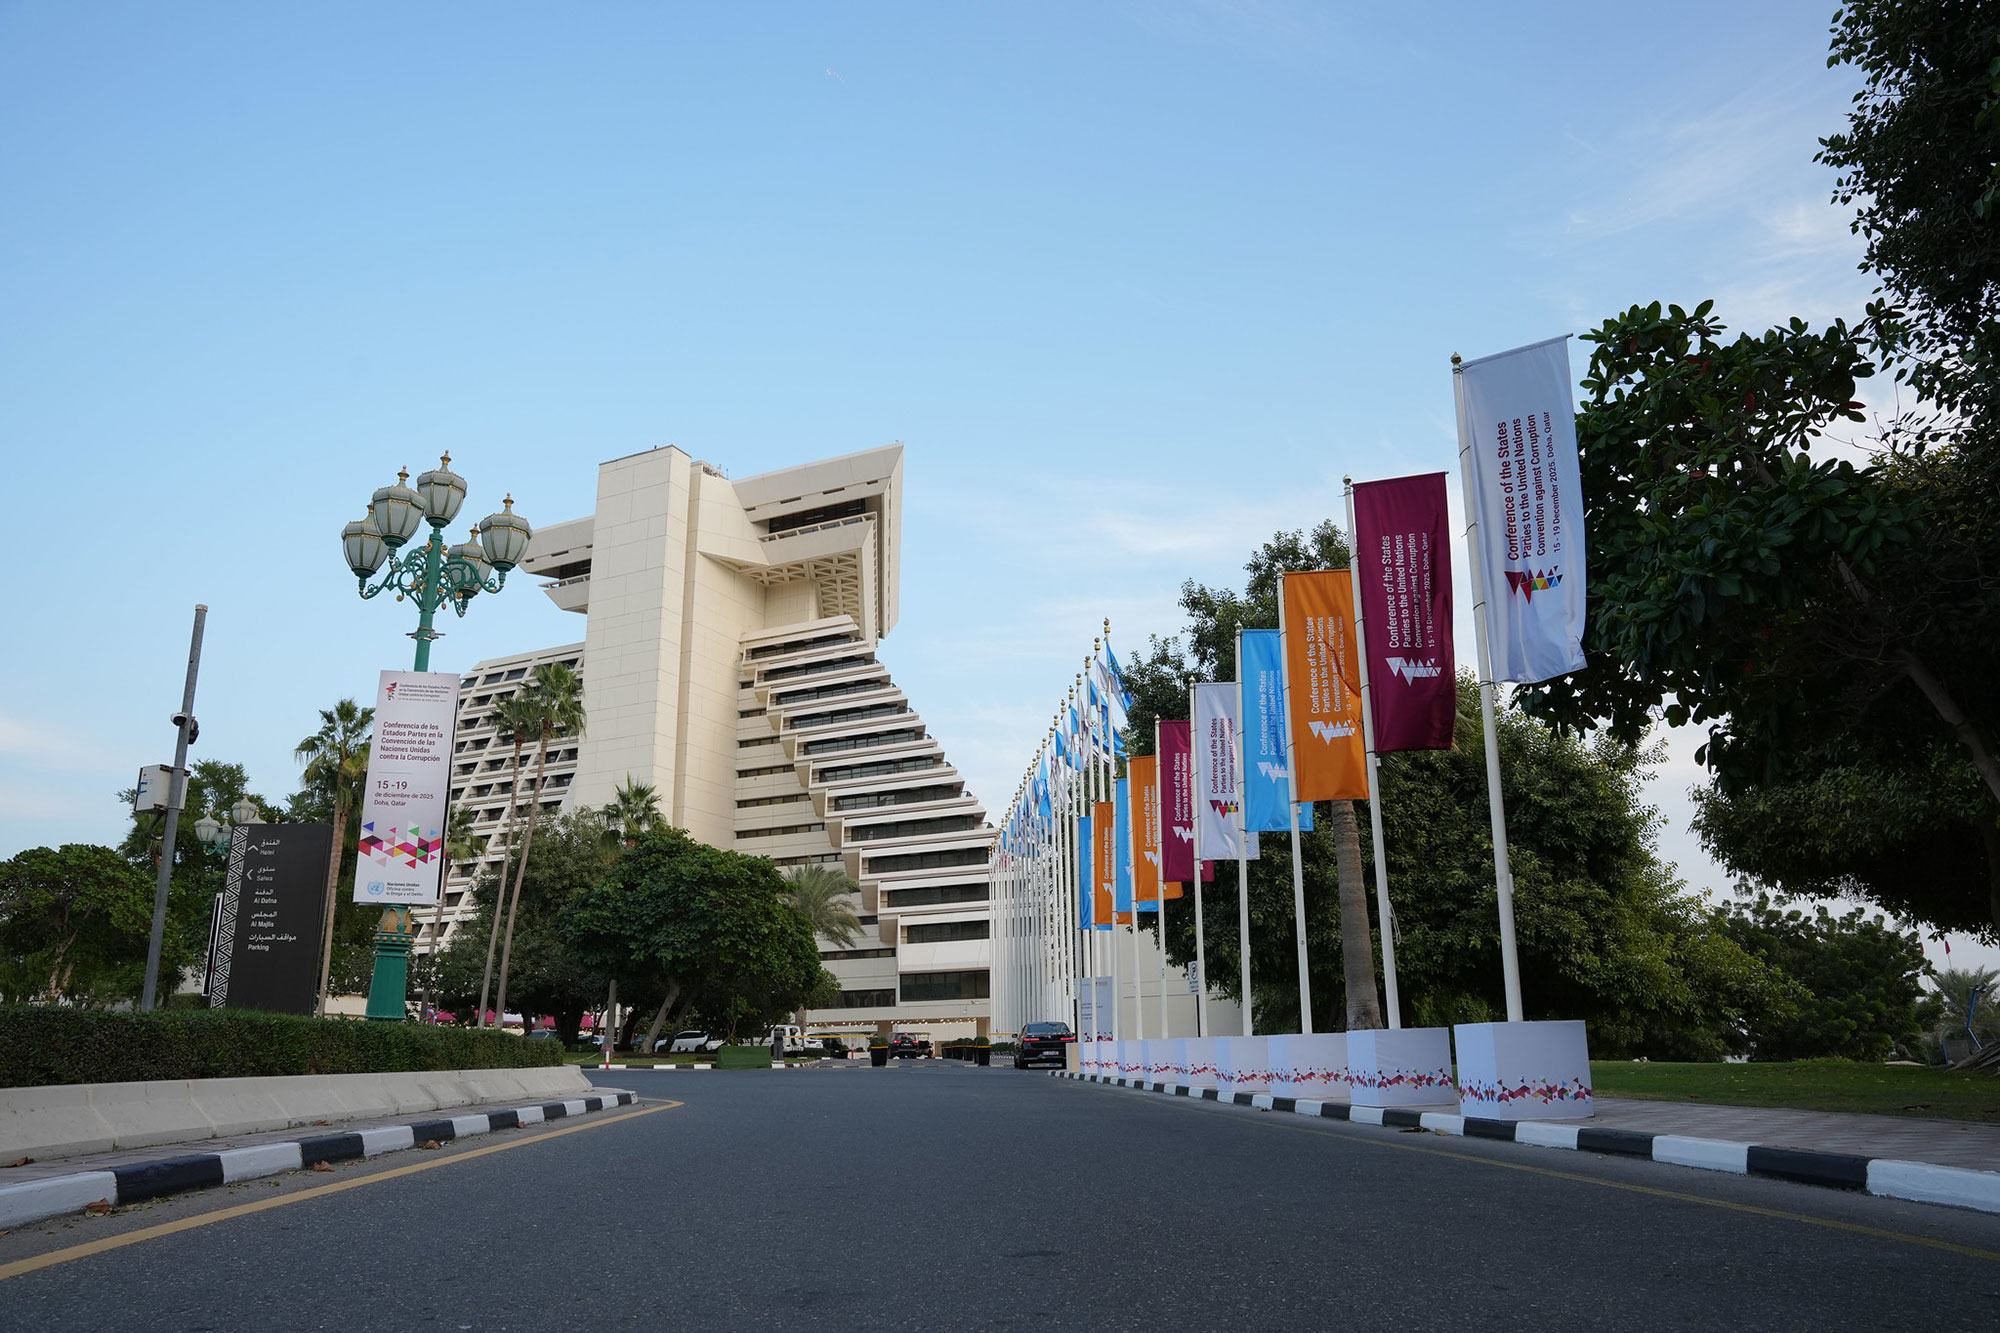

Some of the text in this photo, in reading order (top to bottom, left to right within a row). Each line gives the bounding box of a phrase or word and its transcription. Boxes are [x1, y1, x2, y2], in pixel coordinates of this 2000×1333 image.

[1546, 434, 1554, 458] Doha,
[1497, 422, 1519, 560] Conference of the States
[1512, 418, 1532, 559] Parties to the United Nations
[1527, 414, 1545, 556] Convention against Corruption
[1552, 484, 1560, 524] December
[1553, 526, 1560, 535] 19
[1554, 542, 1560, 552] 15
[1382, 535, 1399, 648] Conference of the States
[1394, 535, 1411, 647] Parties to the United Nations
[1407, 533, 1422, 648] Convention against Corruption
[1306, 616, 1320, 713] Conference of the States
[1318, 643, 1327, 666] United
[1259, 706, 1267, 714] of
[1322, 688, 1330, 712] Parties
[1332, 674, 1341, 712] Convention
[1260, 715, 1268, 755] Conference
[377, 780, 389, 789] 15
[261, 839, 280, 848] الفندق
[249, 933, 296, 942] مواقف السيارات
